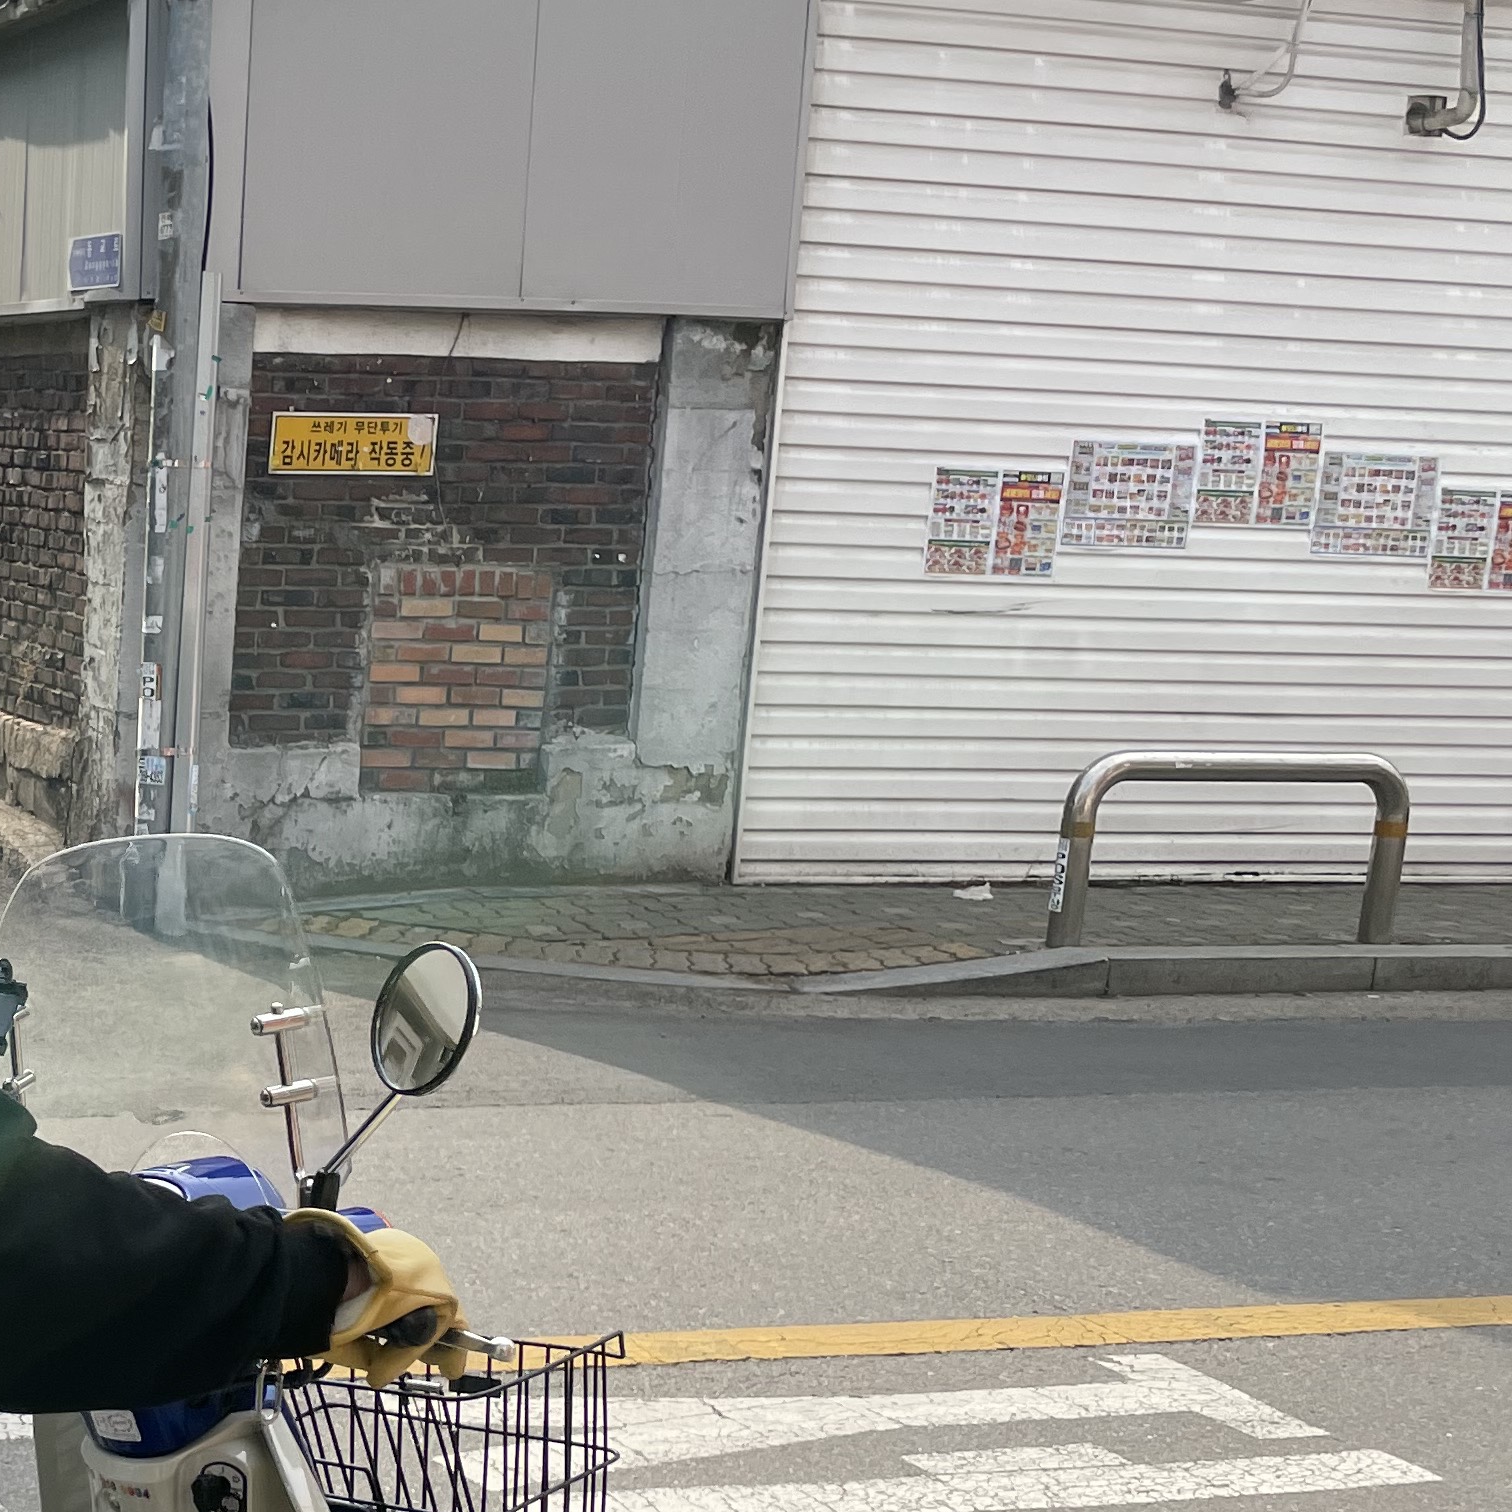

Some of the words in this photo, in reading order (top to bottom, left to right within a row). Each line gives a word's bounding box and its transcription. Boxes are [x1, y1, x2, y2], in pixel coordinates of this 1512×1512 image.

[310, 420, 348, 434] 쓰레기
[354, 420, 403, 436] 무단투기
[281, 438, 360, 467] 감시카메라
